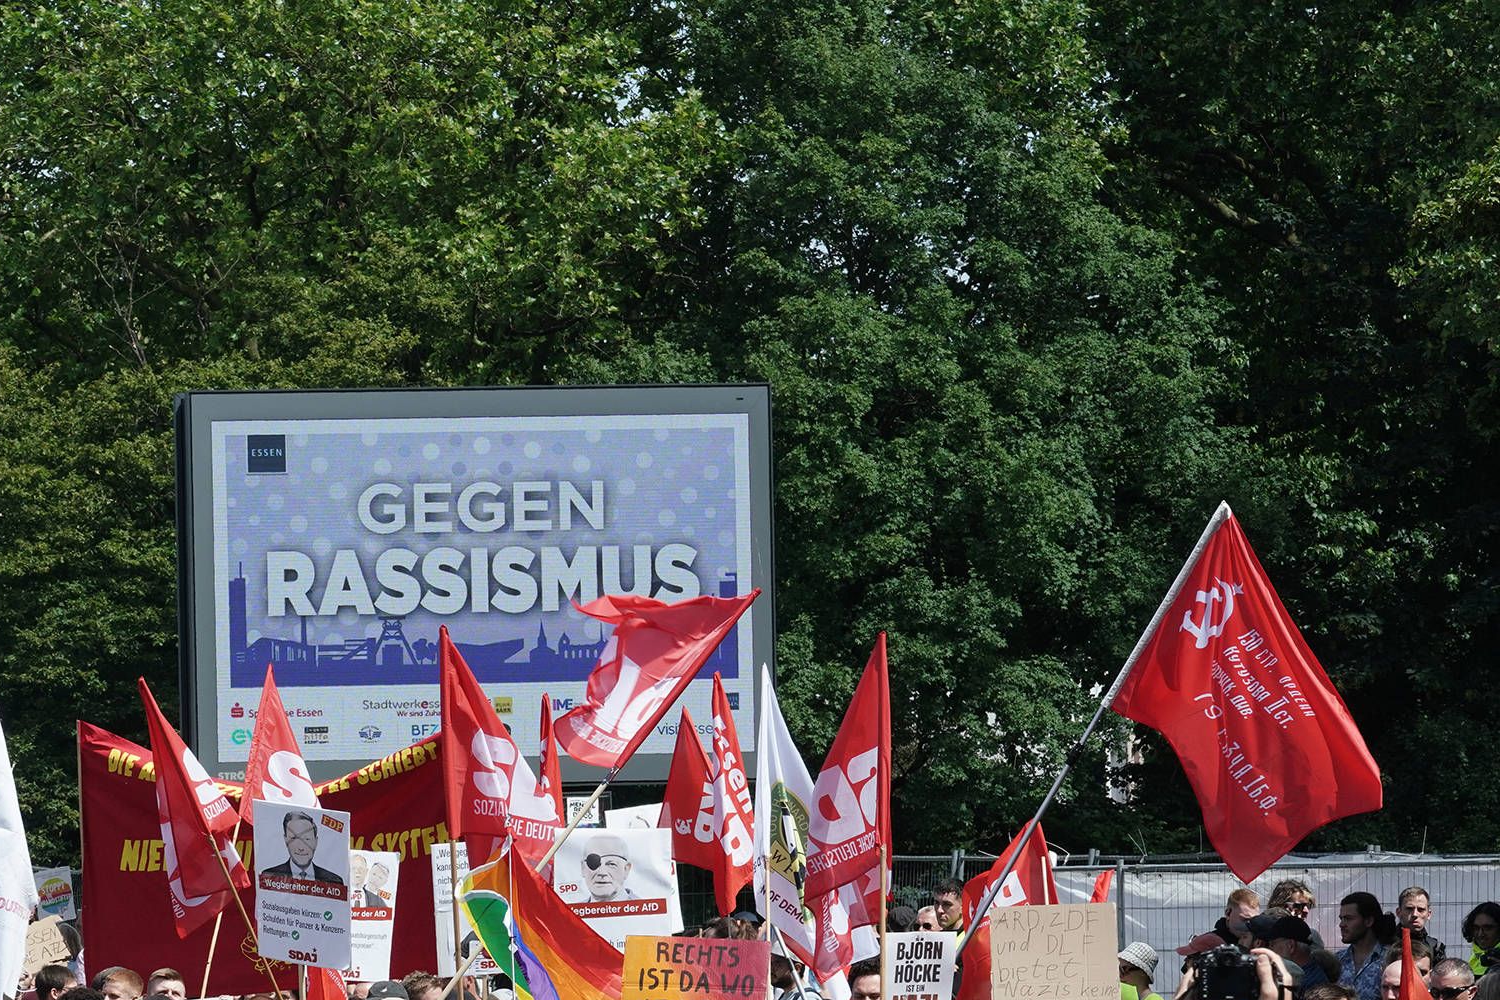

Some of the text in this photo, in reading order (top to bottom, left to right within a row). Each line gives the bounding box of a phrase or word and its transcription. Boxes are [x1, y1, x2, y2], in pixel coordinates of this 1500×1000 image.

[251, 449, 283, 458] ESSEN
[357, 480, 604, 534] GEGEN
[267, 543, 700, 617] RASSISMUS
[297, 708, 323, 717] Essen
[108, 748, 141, 777] DIE
[356, 741, 438, 787] SCHIEBT
[217, 771, 246, 781] STRÖ
[323, 814, 344, 832] FDP
[265, 880, 341, 896] Wegbereiter der AfD
[560, 883, 578, 893] SPD
[262, 900, 322, 920] Sozialausgaben kürzen:
[572, 904, 620, 917] egbereiter
[642, 903, 659, 911] AfD
[262, 913, 286, 925] Schulden
[286, 916, 294, 926] für
[295, 919, 313, 931] Panzer
[995, 909, 1045, 932] ARD,
[896, 937, 944, 960] BJÖRN
[997, 929, 1032, 956] und
[288, 948, 318, 963] SDAJ
[657, 942, 740, 968] RECHTS
[894, 960, 941, 983] HÖCKE
[639, 968, 756, 997] IST DA WO
[906, 984, 925, 993] IST EIN
[1004, 981, 1071, 998] Nazis
